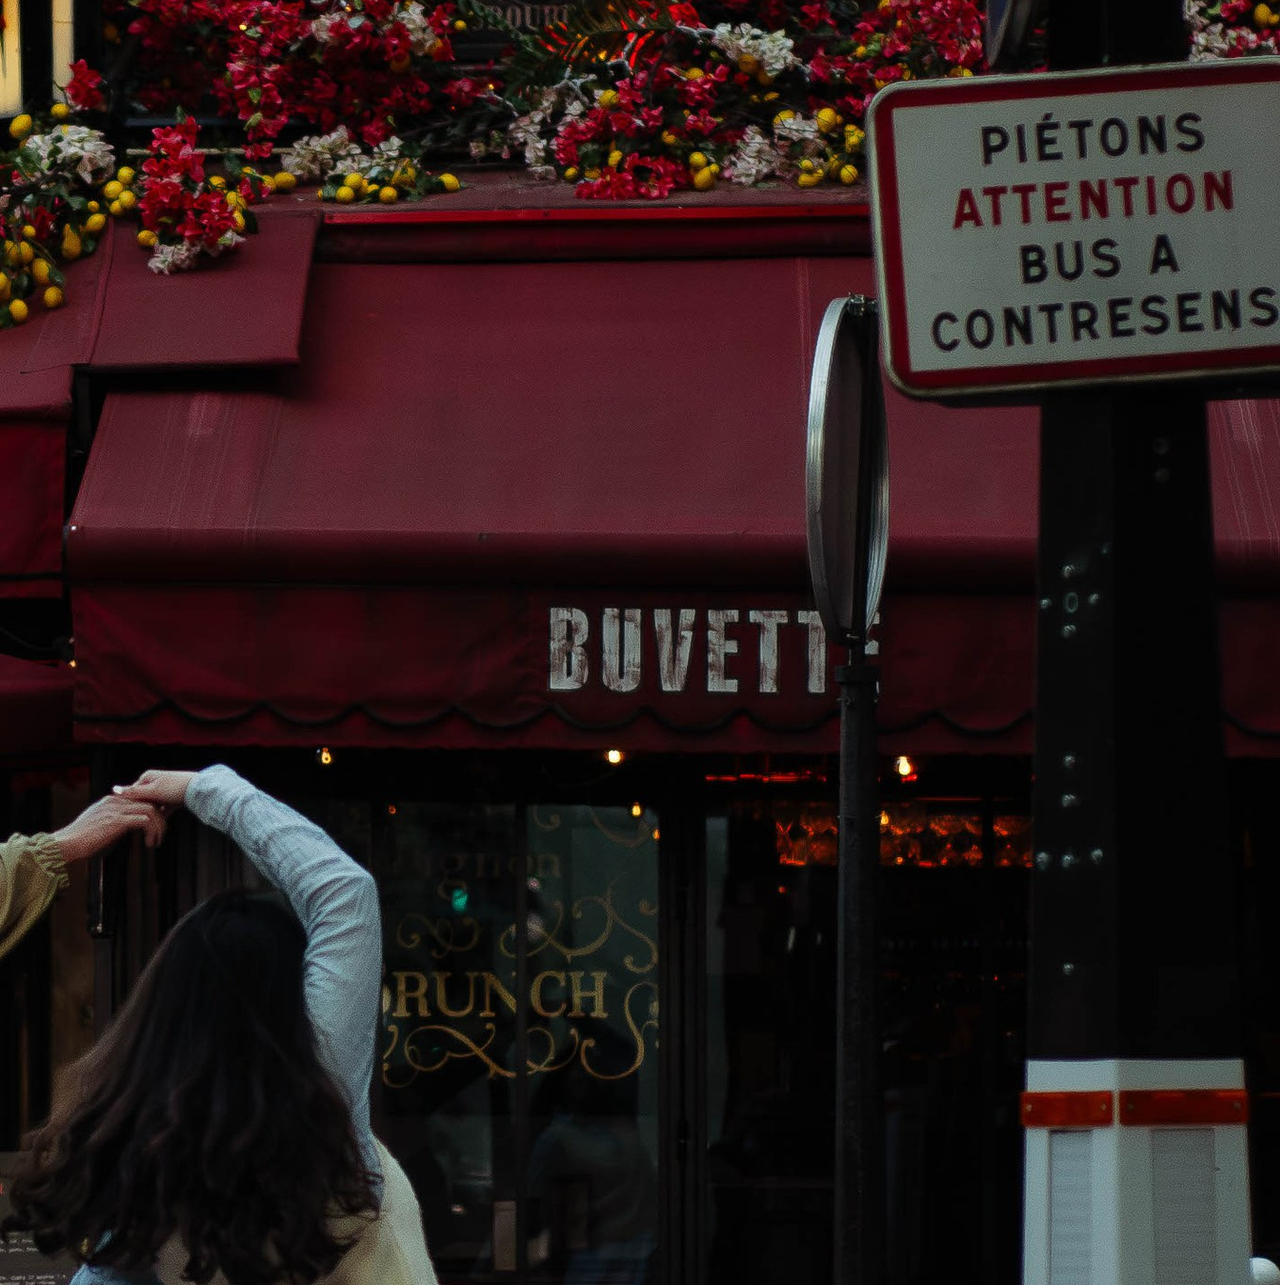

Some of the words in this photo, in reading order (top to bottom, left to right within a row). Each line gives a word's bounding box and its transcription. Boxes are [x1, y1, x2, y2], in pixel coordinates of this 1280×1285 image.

[980, 112, 1206, 166] PIÉTONS
[952, 169, 1235, 229] ATTENTION
[1019, 237, 1122, 285] BUS
[1149, 233, 1180, 275] A
[930, 285, 1280, 352] CONTRESENS
[548, 606, 881, 694] BUVETT
[382, 970, 609, 1019] RUNCH
